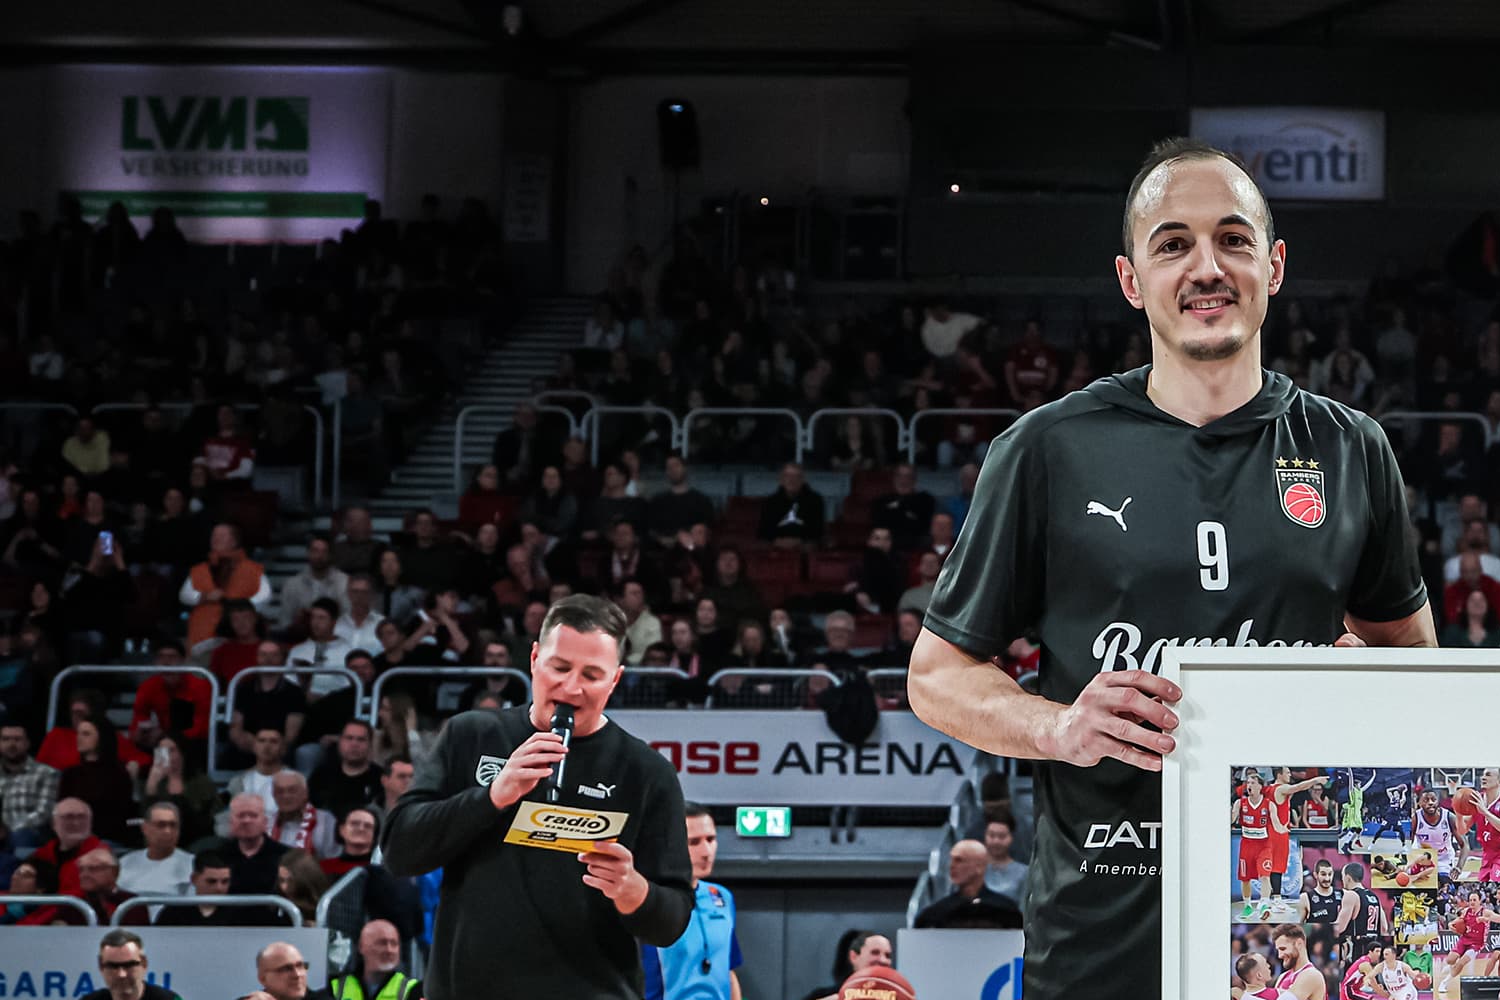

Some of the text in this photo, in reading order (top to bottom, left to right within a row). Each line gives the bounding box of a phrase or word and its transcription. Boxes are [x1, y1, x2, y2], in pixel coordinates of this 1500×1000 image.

[121, 96, 247, 150] LVM
[120, 157, 309, 177] VERSICHERUNG
[1279, 472, 1320, 481] BAMBERG
[1196, 521, 1229, 591] 9
[651, 742, 965, 775] ose ARENA
[543, 814, 602, 829] radio
[1083, 820, 1162, 849] DAT
[1079, 859, 1088, 873] A
[1367, 905, 1379, 931] 21
